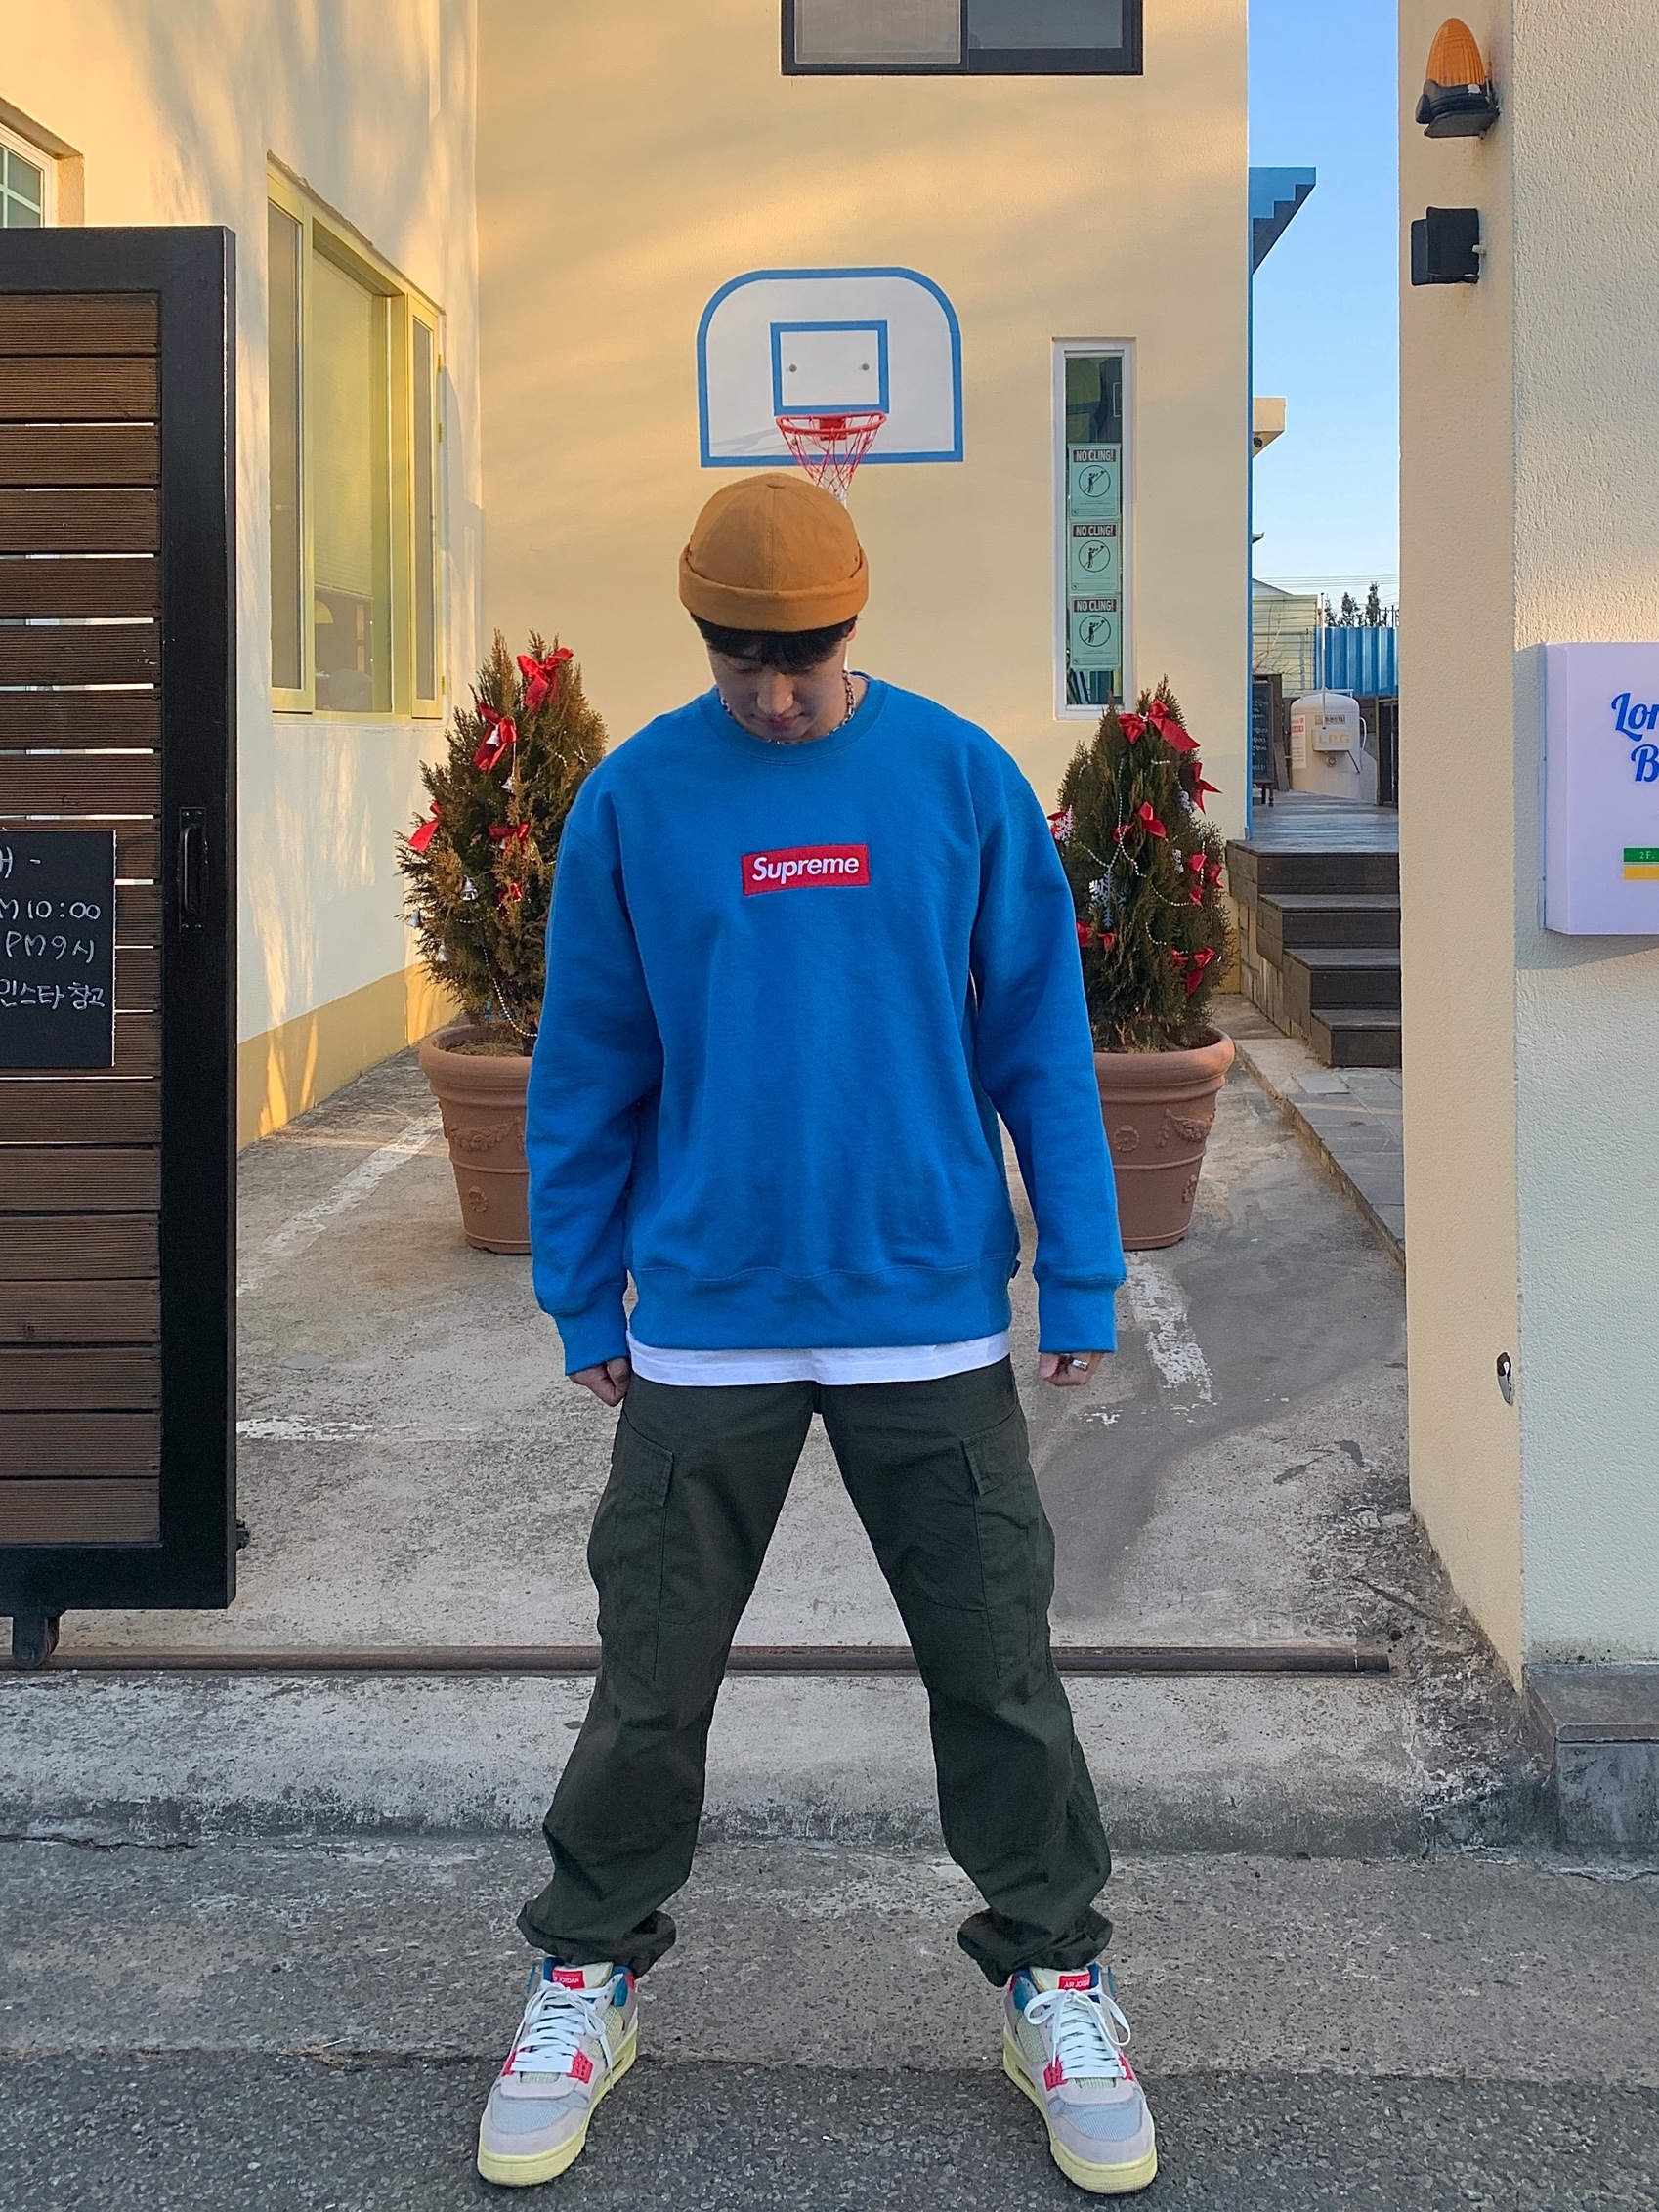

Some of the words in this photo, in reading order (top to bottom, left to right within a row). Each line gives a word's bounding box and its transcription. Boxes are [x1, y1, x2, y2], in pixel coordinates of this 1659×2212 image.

[1076, 450, 1086, 461] NO
[1088, 449, 1114, 461] CLING!
[1076, 526, 1086, 536] NO
[1088, 525, 1114, 536] CLING!
[1077, 600, 1087, 612] NO
[1089, 599, 1114, 612] CLING!
[1318, 734, 1350, 744] LPG
[751, 856, 860, 885] Supreme
